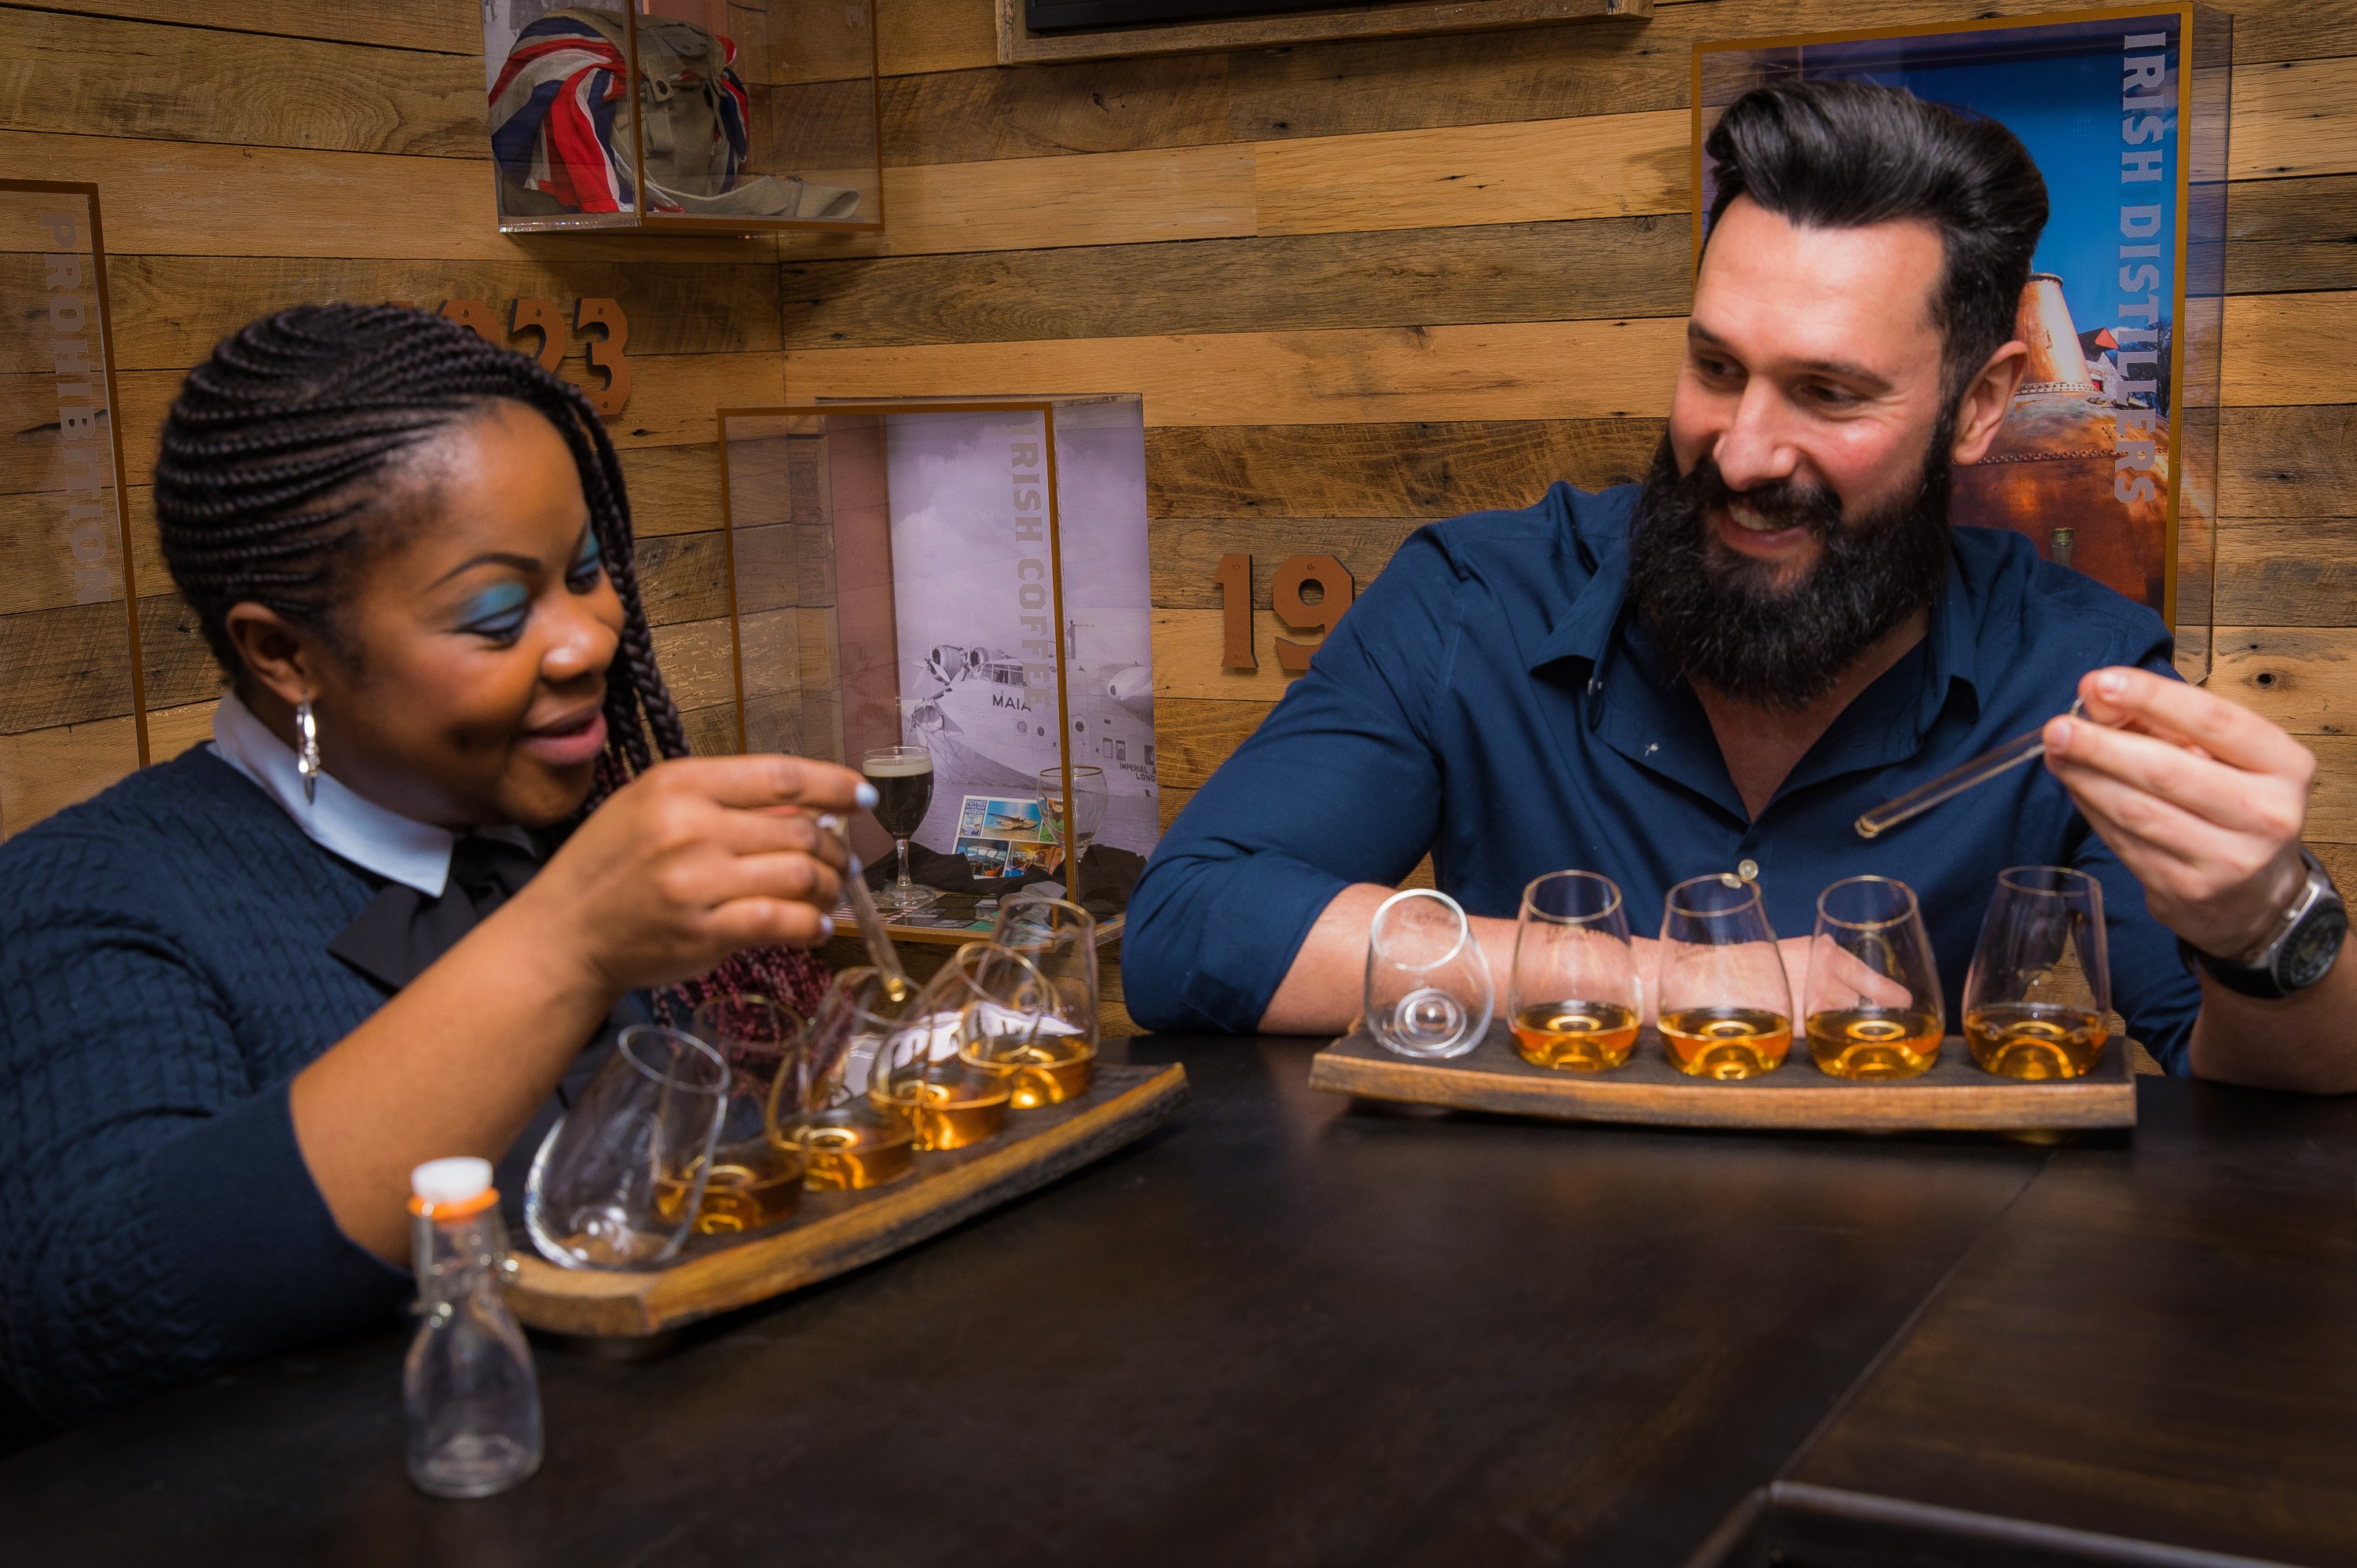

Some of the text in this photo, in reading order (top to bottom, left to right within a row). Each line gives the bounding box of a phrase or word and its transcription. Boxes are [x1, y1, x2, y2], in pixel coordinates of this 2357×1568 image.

[40, 213, 112, 604] PROHIBITION
[2113, 31, 2166, 504] IRISH DISTILLERS
[1010, 424, 1051, 709] IRISH COFFEE
[1120, 763, 1148, 774] IMPERIAL
